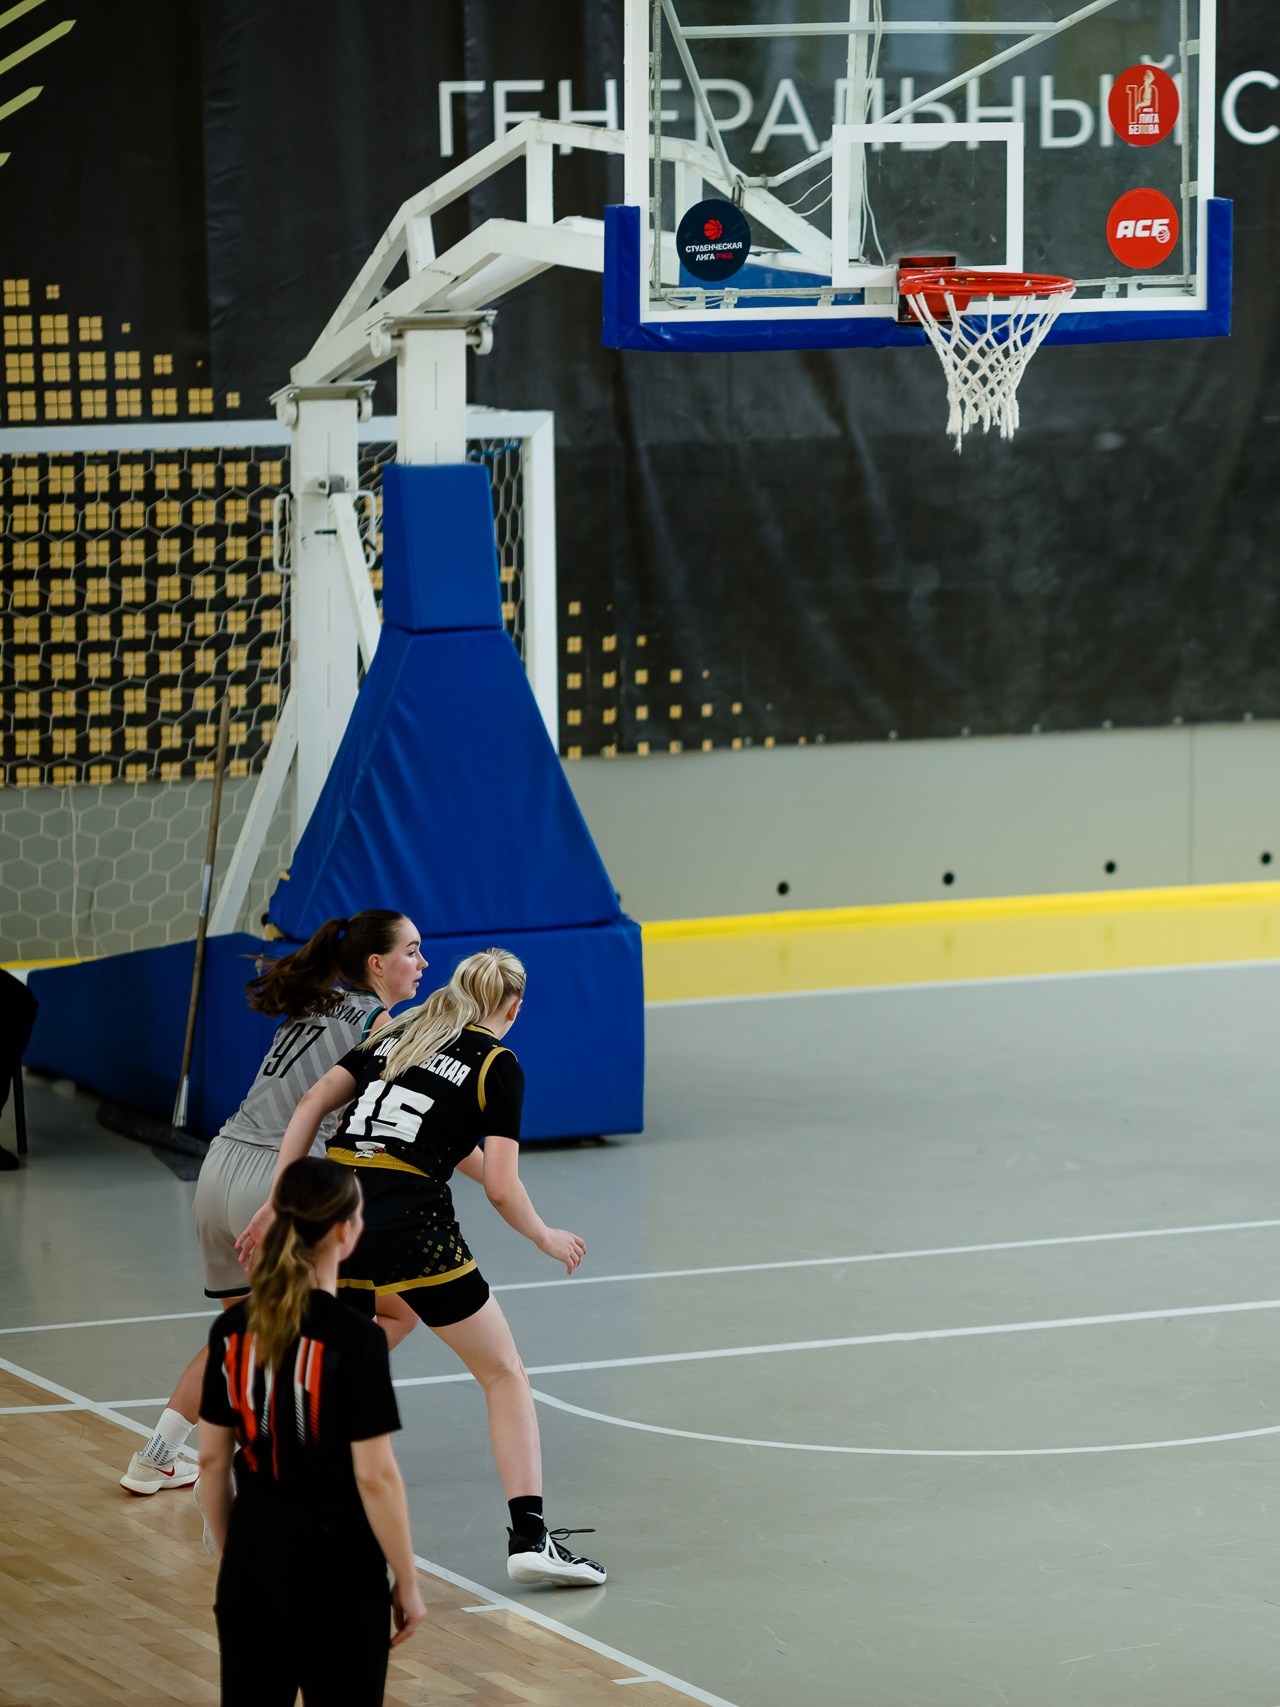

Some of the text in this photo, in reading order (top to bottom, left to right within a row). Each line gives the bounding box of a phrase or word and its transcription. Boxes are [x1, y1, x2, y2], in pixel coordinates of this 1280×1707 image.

[685, 241, 743, 253] СТУДЕНЧЕСКАЯ
[695, 253, 716, 262] ЛИГА
[262, 1022, 328, 1079] 97
[345, 1079, 435, 1144] 15
